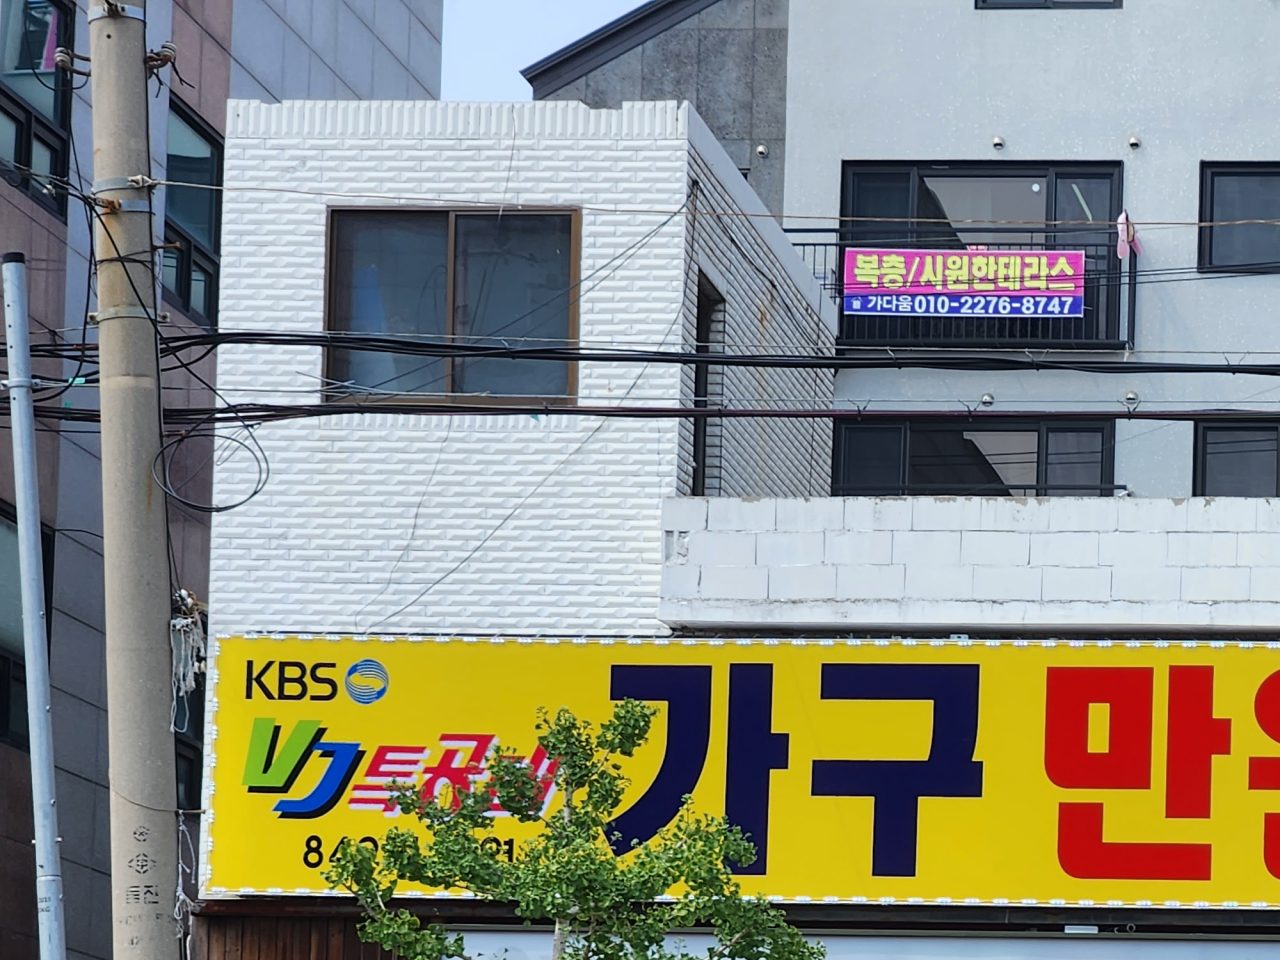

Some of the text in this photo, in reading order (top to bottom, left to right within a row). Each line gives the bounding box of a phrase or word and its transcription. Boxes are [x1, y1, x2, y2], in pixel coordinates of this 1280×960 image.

[854, 254, 1075, 291] 복층/시원한테라스
[868, 294, 1074, 314] 가다움 010-2276-8747
[245, 660, 338, 701] KBS
[605, 663, 983, 876] 가구
